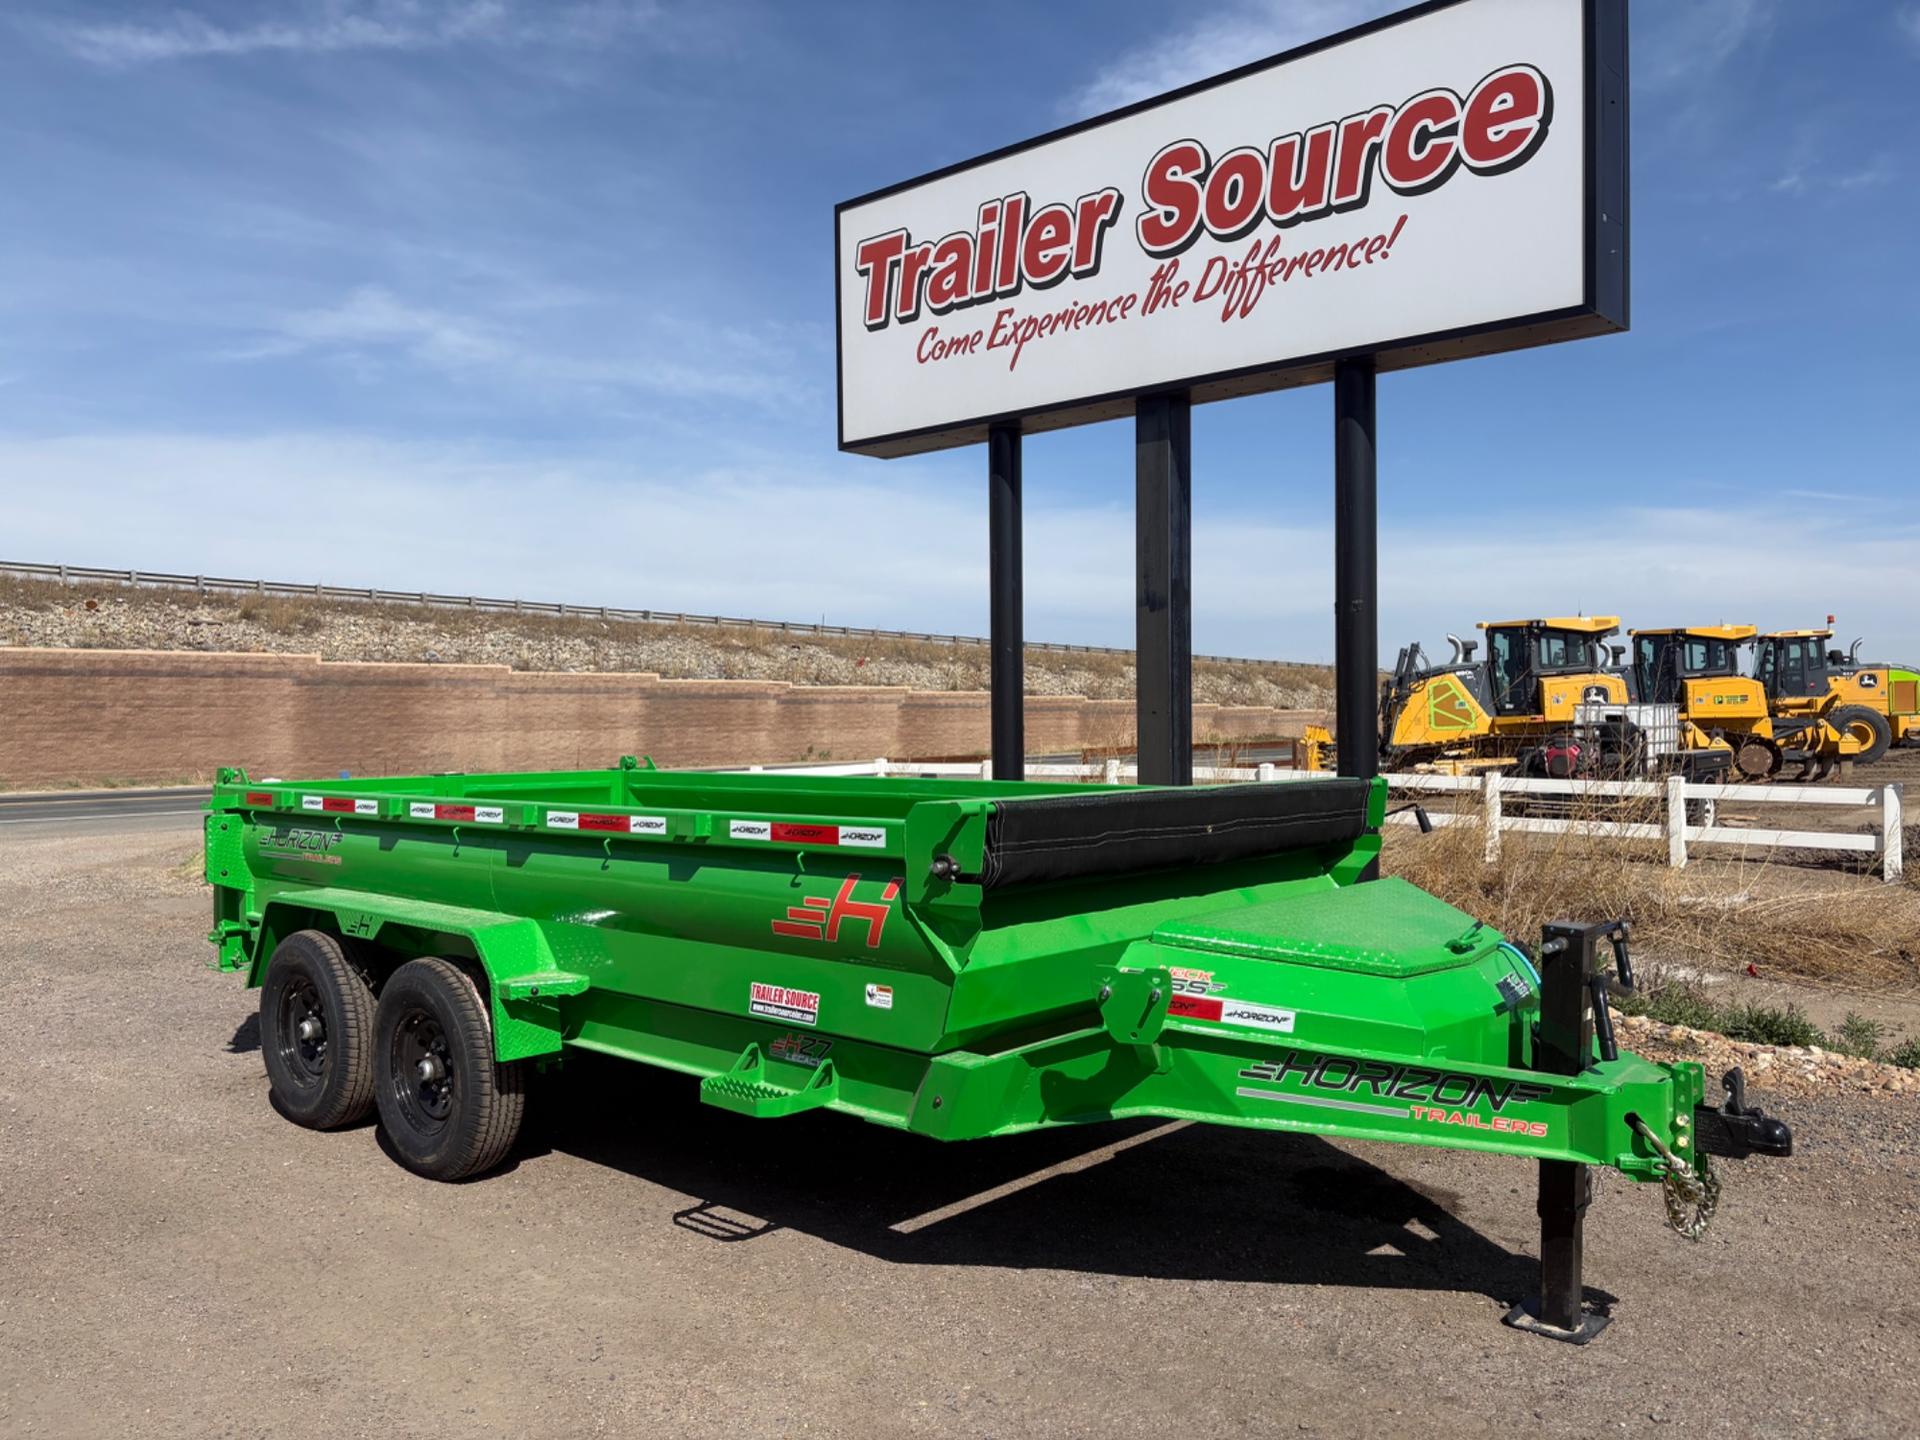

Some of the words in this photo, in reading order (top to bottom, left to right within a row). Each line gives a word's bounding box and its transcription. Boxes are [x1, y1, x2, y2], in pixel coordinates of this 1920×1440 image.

[856, 187, 1121, 331] Trailer
[1136, 63, 1553, 259] Source
[916, 326, 984, 364] Come
[986, 307, 1137, 372] Experience
[1141, 258, 1190, 317] the
[1192, 214, 1409, 323] Difference!
[752, 984, 784, 1004] TRAILER
[785, 990, 819, 1010] SOURCE
[1231, 1010, 1286, 1023] HORIZON
[1274, 1051, 1516, 1112] HORIZON
[1409, 1105, 1548, 1137] TRAILERS
